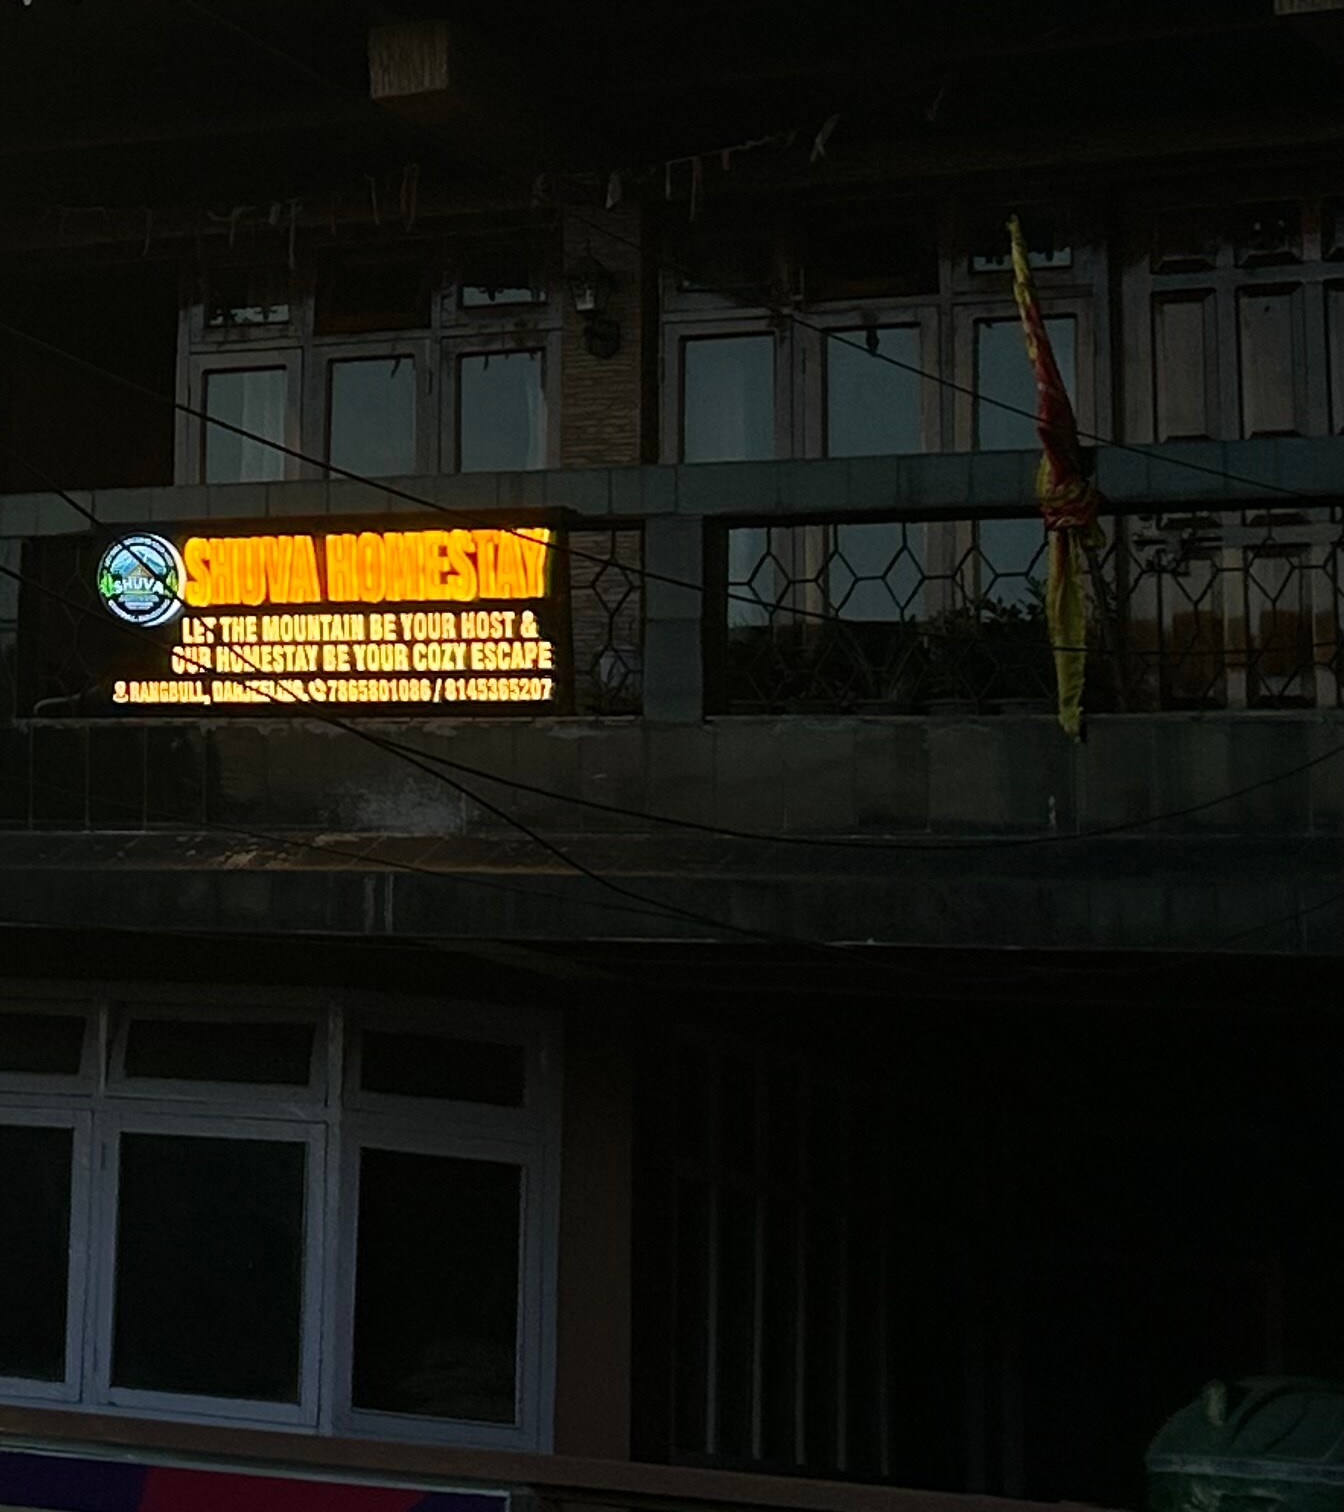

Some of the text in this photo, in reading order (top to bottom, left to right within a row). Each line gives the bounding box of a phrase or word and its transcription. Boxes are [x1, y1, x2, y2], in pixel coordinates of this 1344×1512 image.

[184, 534, 321, 607] SHUVA
[325, 527, 550, 603] HOMESTAY
[114, 576, 165, 595] SHUVA
[182, 609, 540, 644] LET THE MOUNTAIN BE YOUR HOST &
[171, 641, 553, 674] OUR HOMESTAY BE YOUR COZY ESCAPE
